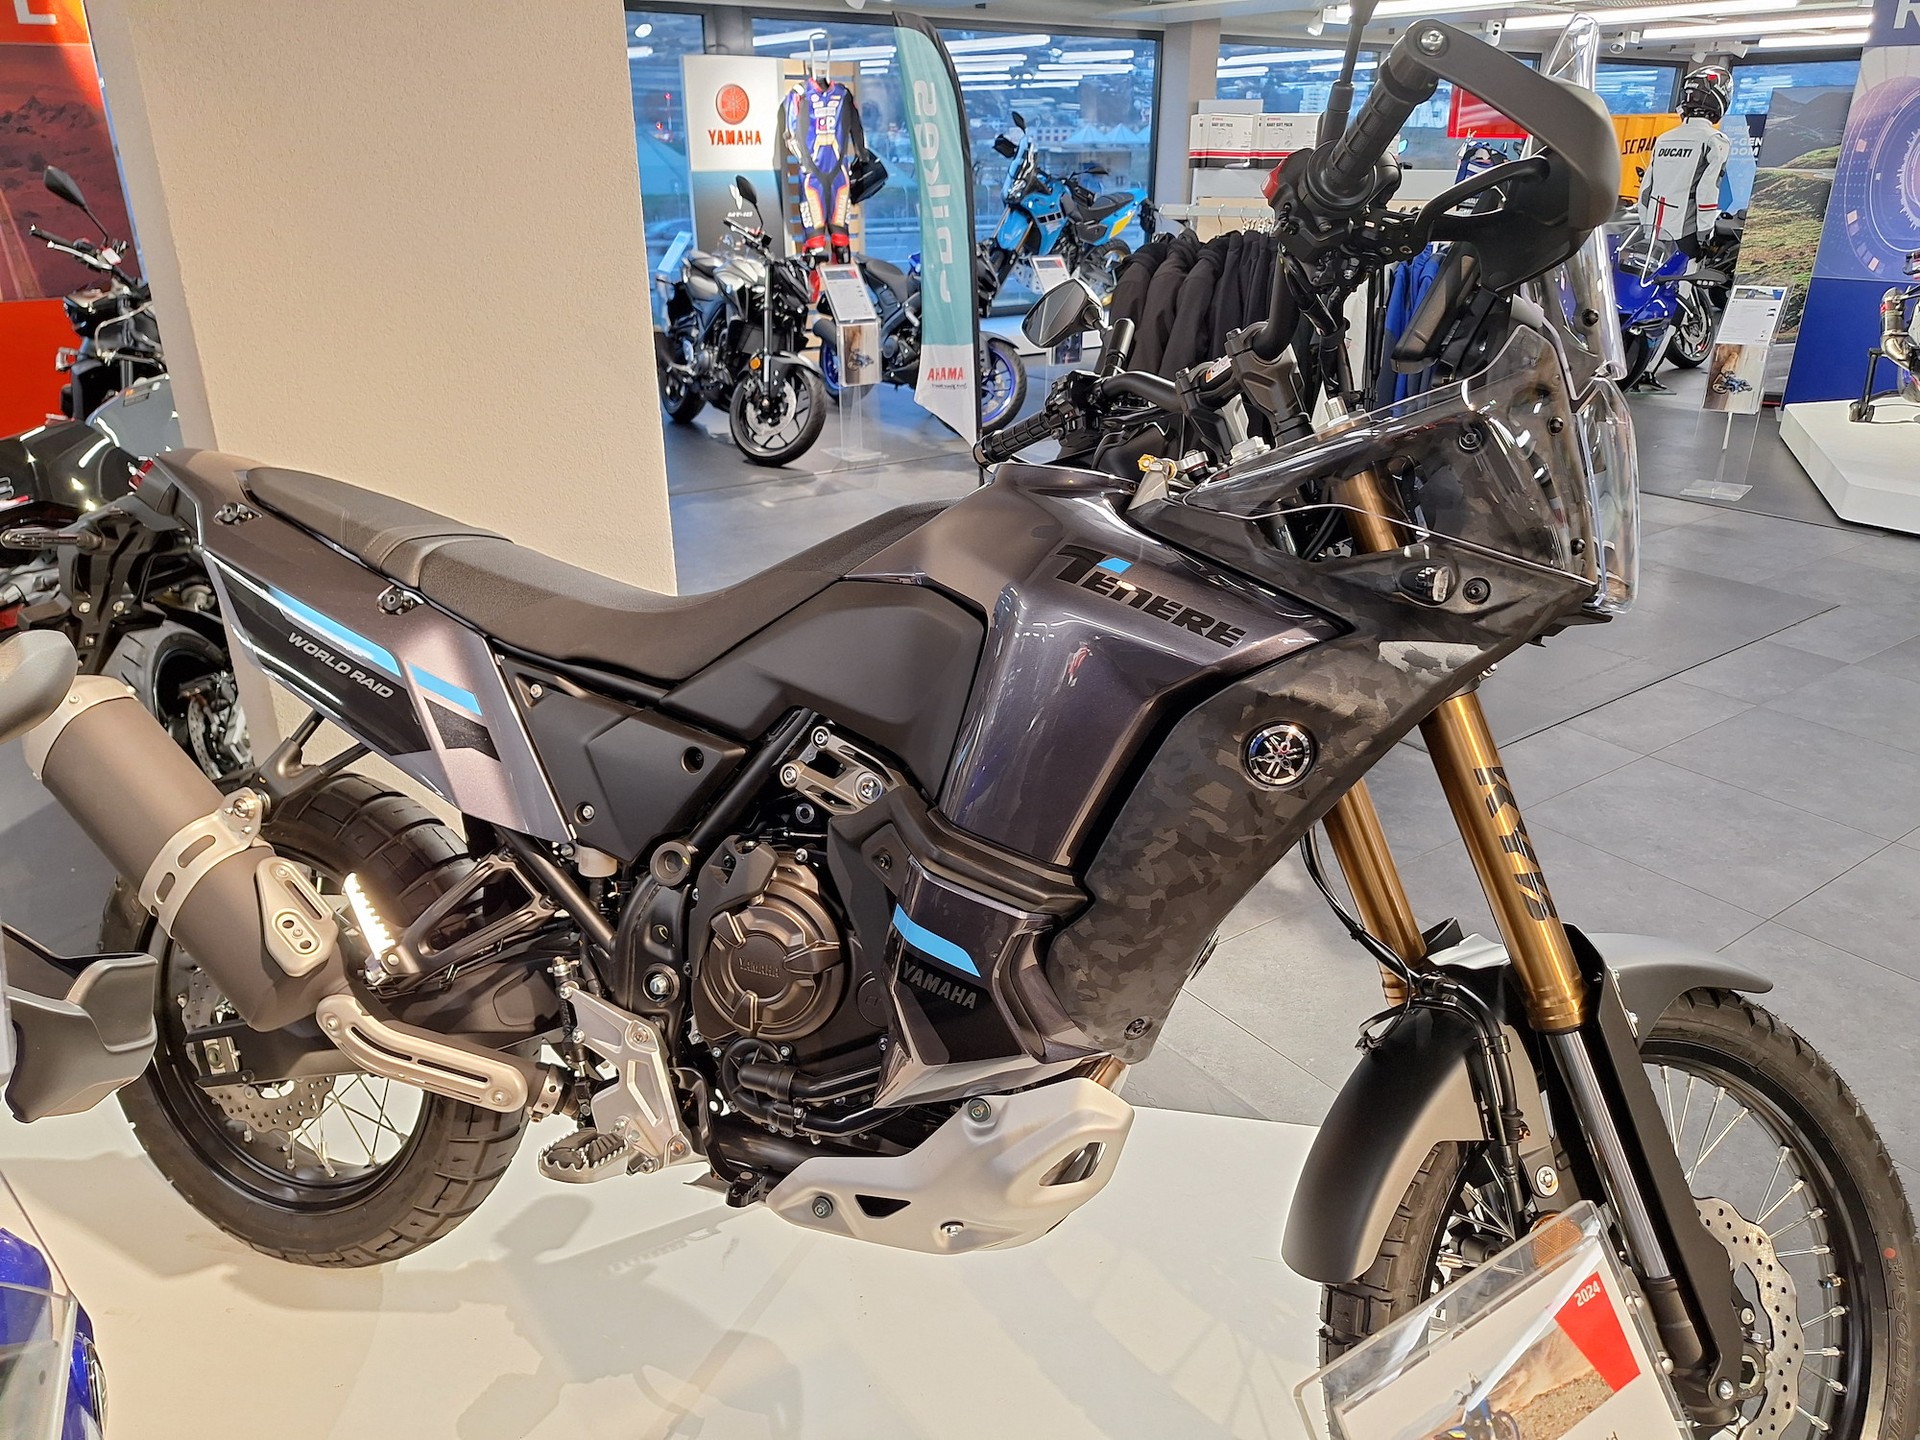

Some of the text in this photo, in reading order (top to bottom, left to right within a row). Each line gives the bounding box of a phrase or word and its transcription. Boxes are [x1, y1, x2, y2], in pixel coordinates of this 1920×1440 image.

[707, 129, 762, 146] YAMAHA
[1658, 148, 1693, 158] DUCATI
[288, 631, 394, 698] WORLD RAID
[1473, 767, 1556, 920] KYB
[903, 961, 978, 1010] YAMAHA
[1574, 1280, 1601, 1307] 2024
